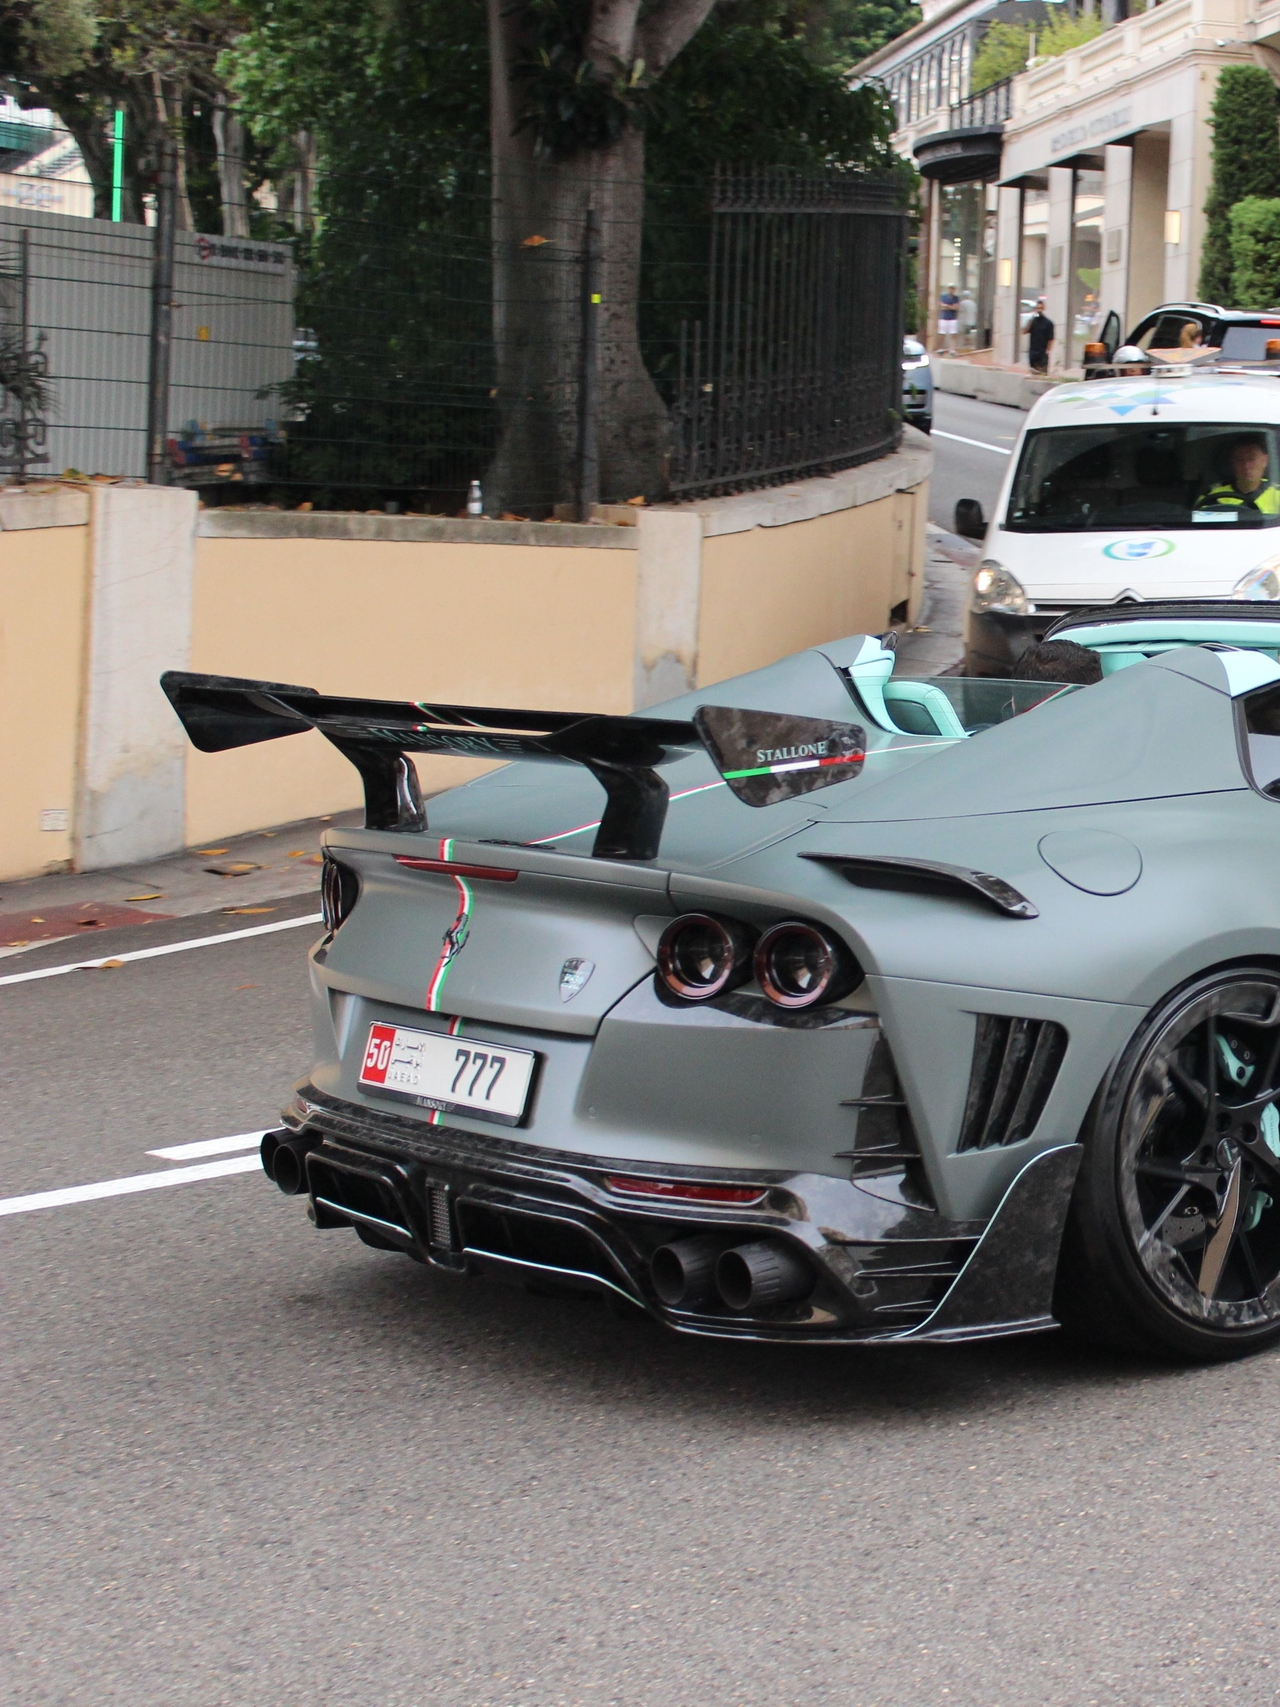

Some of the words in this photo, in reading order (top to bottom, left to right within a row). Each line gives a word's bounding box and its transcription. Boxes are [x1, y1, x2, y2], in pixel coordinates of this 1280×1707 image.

[756, 741, 828, 762] STALLONE
[366, 1038, 393, 1071] 50
[451, 1048, 507, 1101] 777
